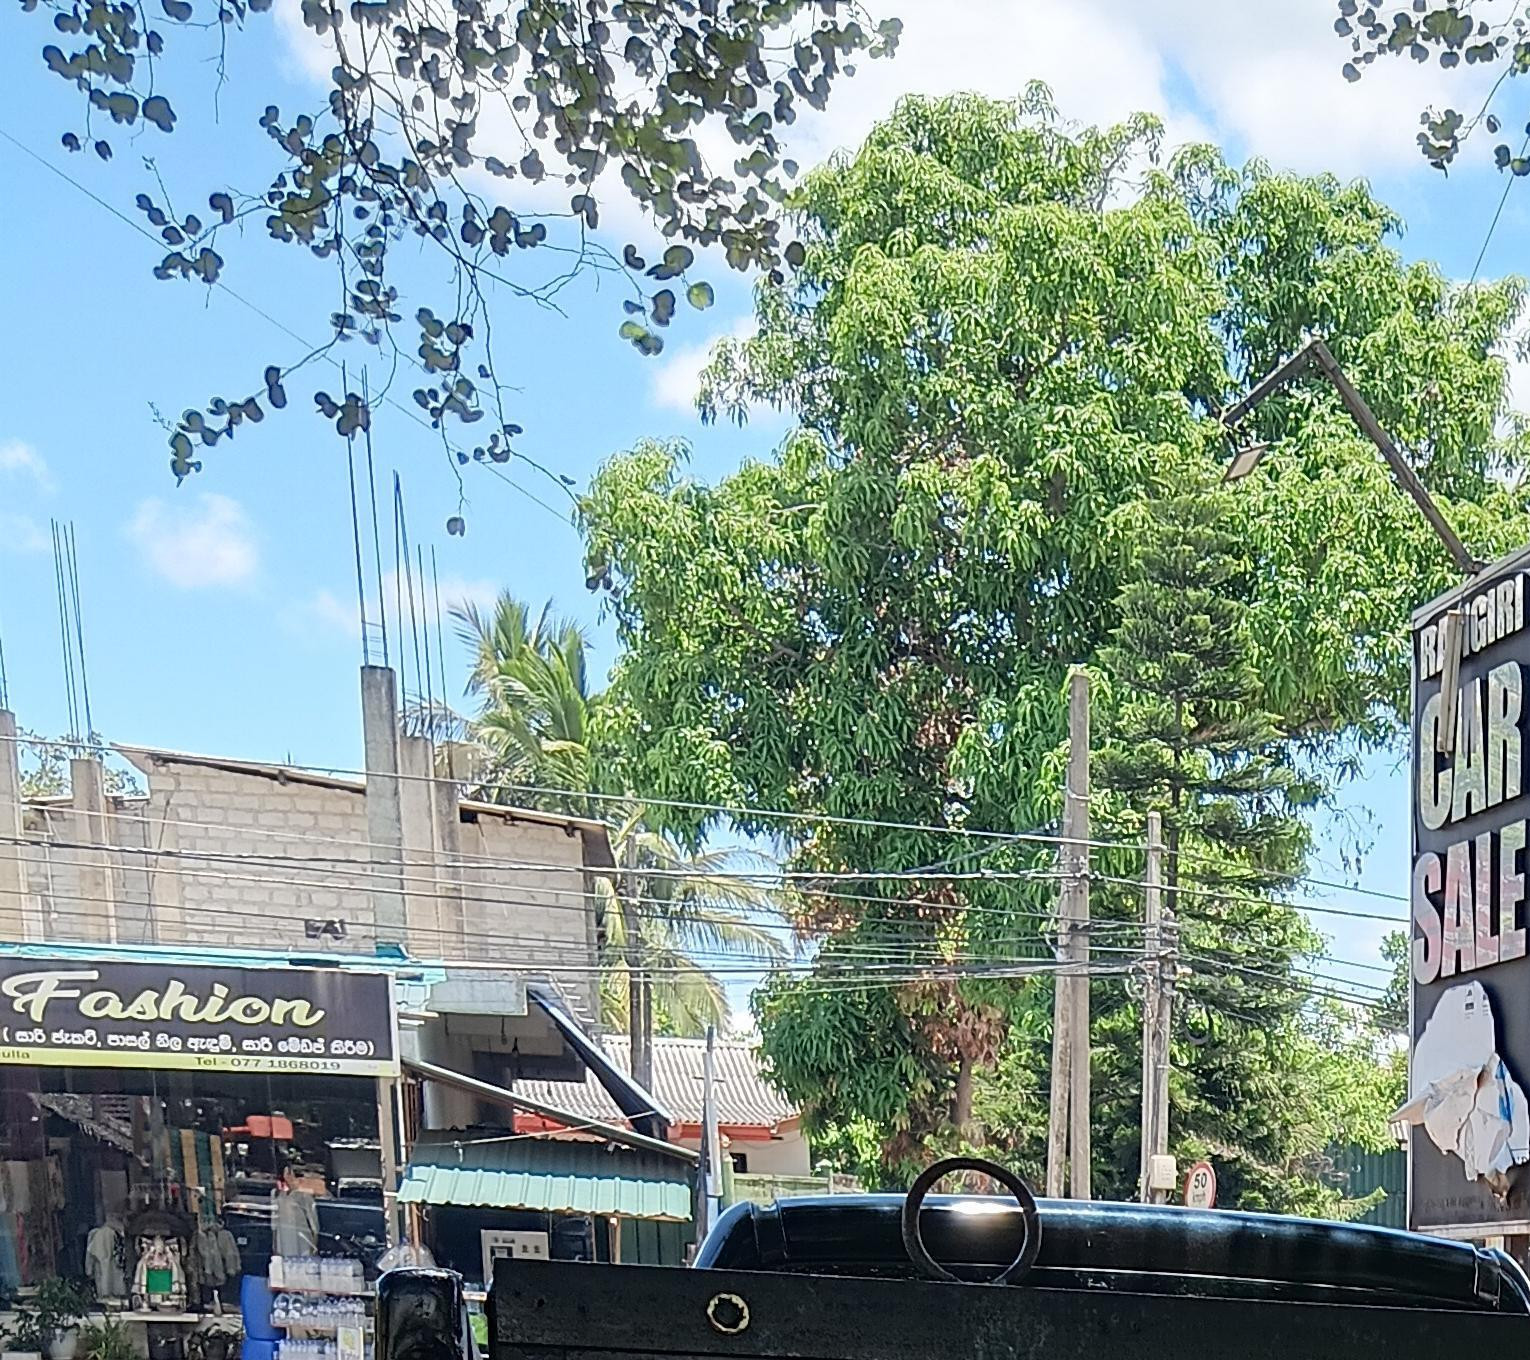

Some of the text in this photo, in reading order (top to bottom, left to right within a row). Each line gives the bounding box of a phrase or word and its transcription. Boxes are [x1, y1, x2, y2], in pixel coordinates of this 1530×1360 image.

[1420, 660, 1523, 831] CAR
[1413, 819, 1527, 985] SALE
[2, 969, 325, 1027] Fashion
[194, 1056, 217, 1066] Tel
[230, 1058, 261, 1067] 077
